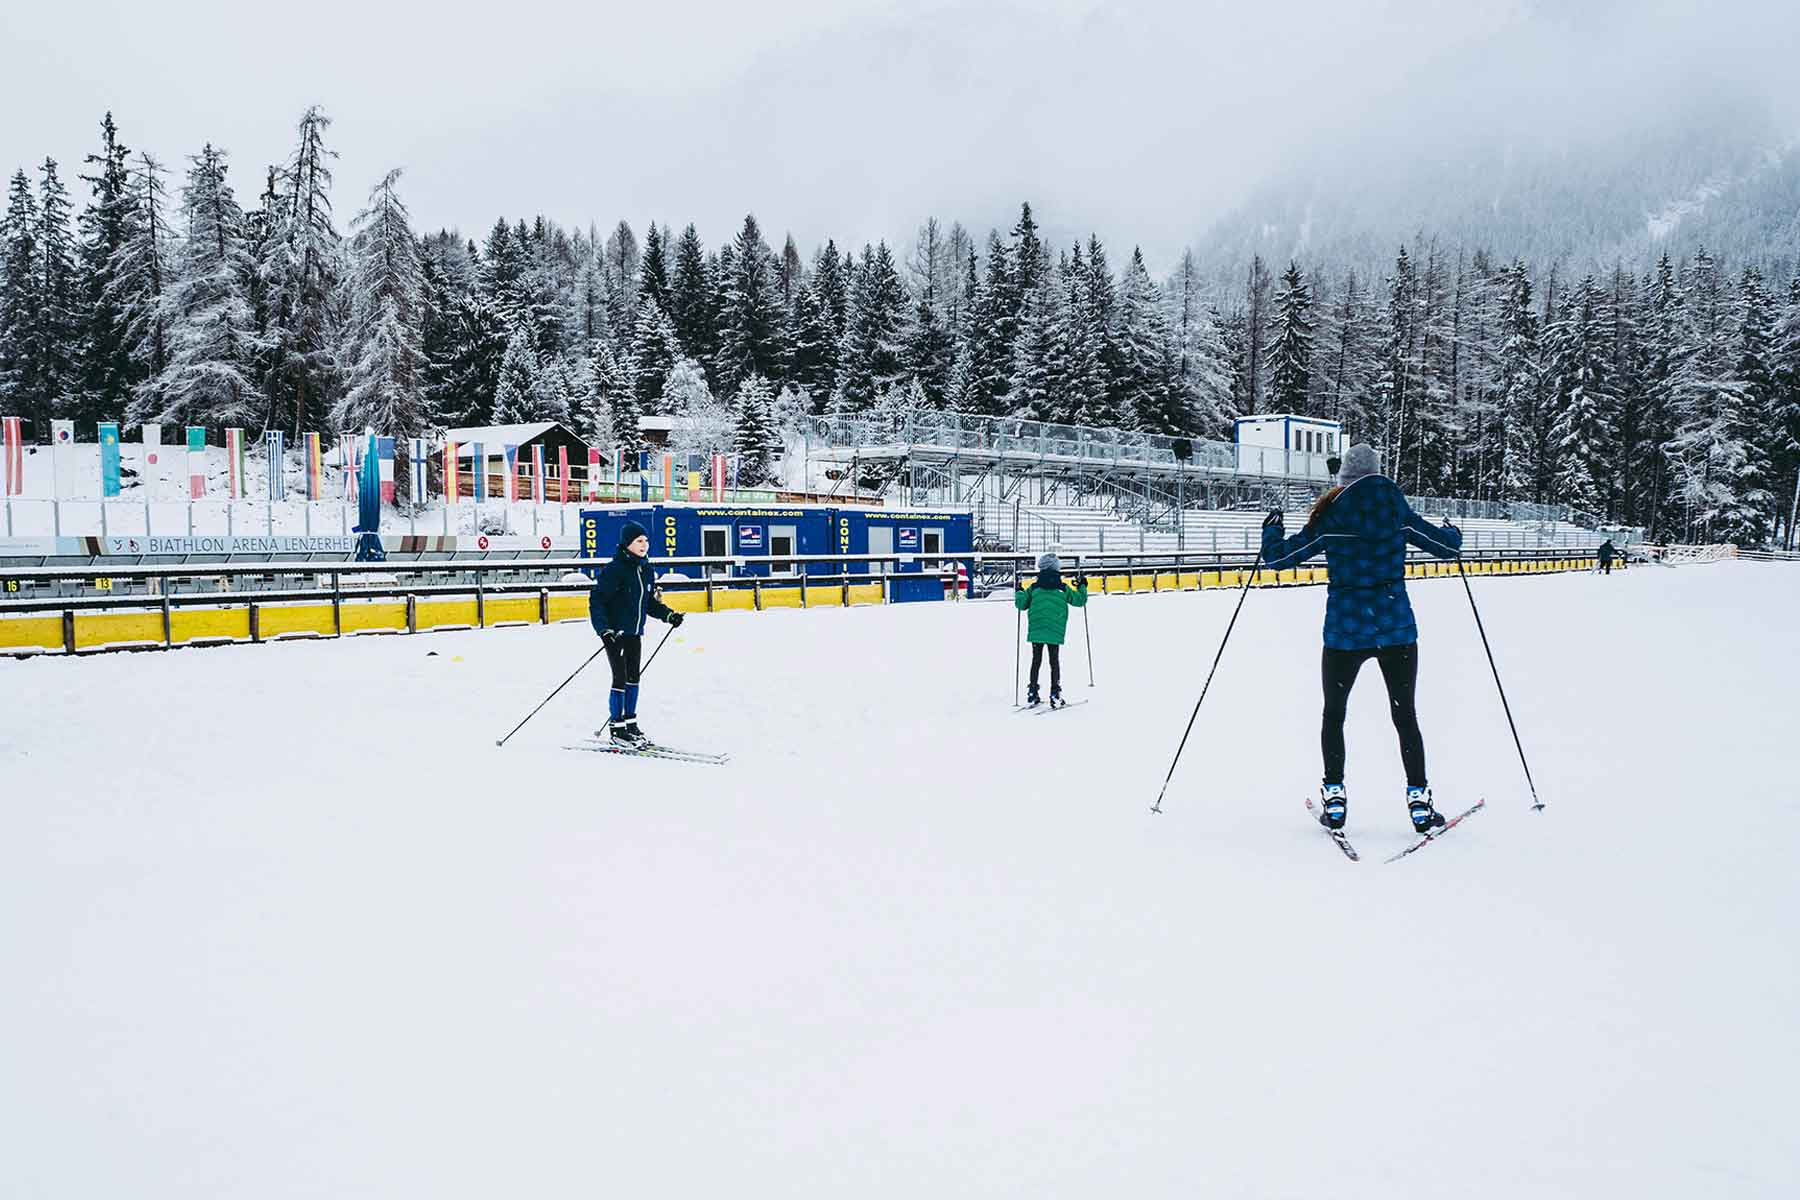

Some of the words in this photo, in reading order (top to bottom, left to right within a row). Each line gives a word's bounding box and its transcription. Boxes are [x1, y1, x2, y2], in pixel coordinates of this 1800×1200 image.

[696, 509, 804, 517] www.containex.com
[864, 512, 951, 520] www.containex.com
[150, 538, 224, 552] BIATHLON
[232, 537, 279, 551] ARENA
[6, 580, 17, 592] 16
[100, 578, 110, 589] 13
